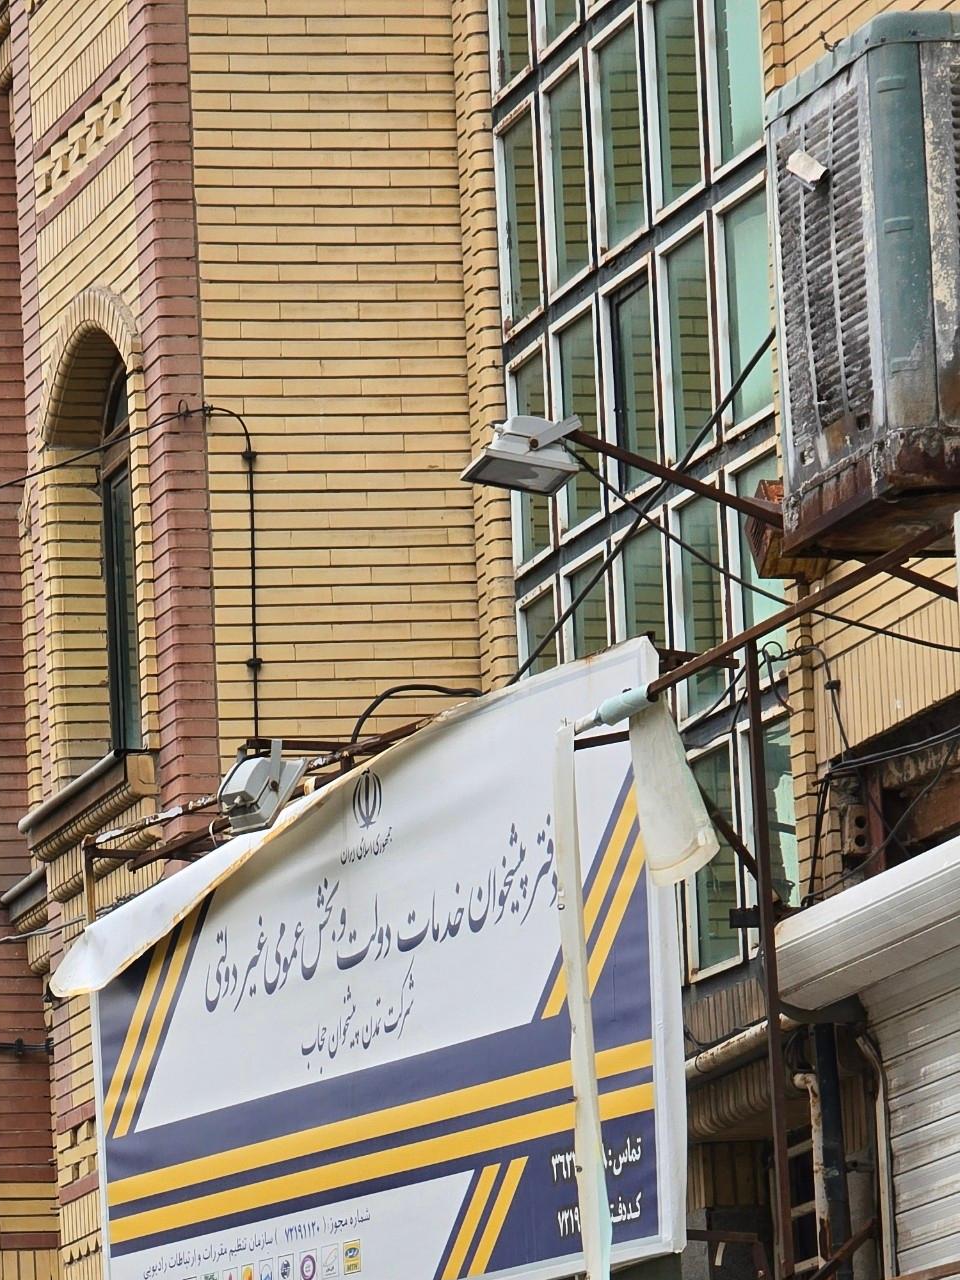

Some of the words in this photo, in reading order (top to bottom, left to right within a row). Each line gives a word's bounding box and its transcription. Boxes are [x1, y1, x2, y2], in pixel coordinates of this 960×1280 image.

[340, 846, 356, 866] ایران
[467, 822, 529, 934] پیشخوان
[520, 813, 559, 926] دفتر
[300, 877, 340, 982] بخش
[336, 892, 392, 971] دولت
[397, 882, 465, 953] خدمات
[205, 924, 238, 1013] دولتی
[233, 913, 269, 1013] غیر
[263, 920, 304, 996] عمومی
[327, 984, 359, 1060] پیشخوان
[383, 954, 415, 1041] شرکت
[229, 1237, 247, 1261] تنظیم
[248, 1231, 273, 1252] سازمان
[349, 1207, 372, 1228] شماره
